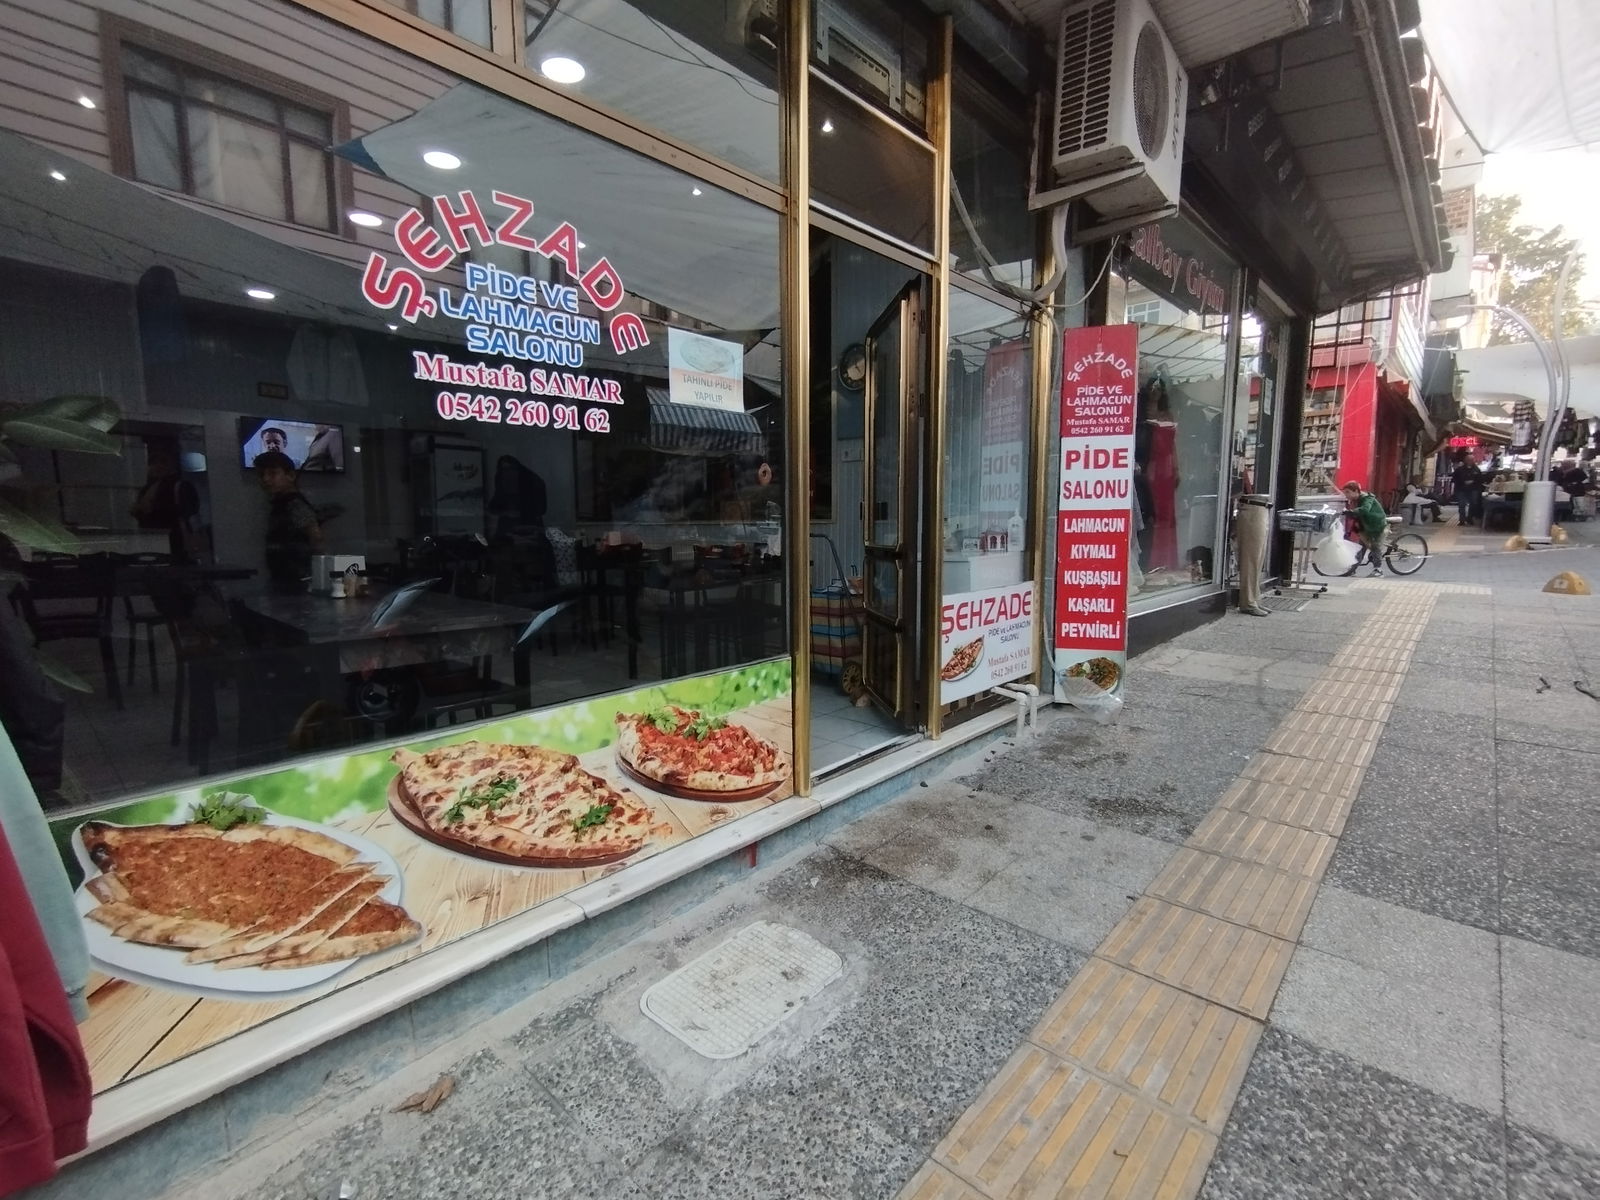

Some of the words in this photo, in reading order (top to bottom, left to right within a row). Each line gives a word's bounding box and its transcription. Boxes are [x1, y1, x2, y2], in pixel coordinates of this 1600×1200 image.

[361, 190, 650, 355] ŞEHZADE
[466, 263, 536, 302] PİDE
[540, 281, 579, 313] VE
[440, 287, 600, 344] LAHMACUN
[467, 324, 583, 367] SALONU
[1067, 351, 1133, 382] ŞEHZADE
[413, 351, 526, 392] Mustafa
[531, 369, 624, 404] SAMAR
[1077, 384, 1104, 396] PİDE
[1107, 385, 1123, 395] VE
[1066, 395, 1132, 407] LAHMACUN
[437, 391, 501, 422] 0542
[505, 398, 549, 427] 260
[553, 404, 580, 430] 91
[584, 408, 610, 432] 62
[1075, 406, 1122, 417] SALONU
[1066, 418, 1097, 426] Mustafa
[1098, 417, 1130, 425] SAMAR
[1071, 427, 1088, 435] 0542
[1090, 426, 1103, 434] 260
[1115, 425, 1124, 433] 62
[1065, 445, 1129, 470] PİDE
[1063, 480, 1129, 500] SALONU
[1064, 518, 1125, 533] LAHMACUN
[1071, 544, 1116, 560] KIYMALI
[1064, 571, 1121, 589] KUŞBAŞILI
[1068, 598, 1115, 616] KAŞARLI
[941, 591, 1032, 643] ŞEHZADE
[1061, 621, 1121, 640] PEYNİRLİ
